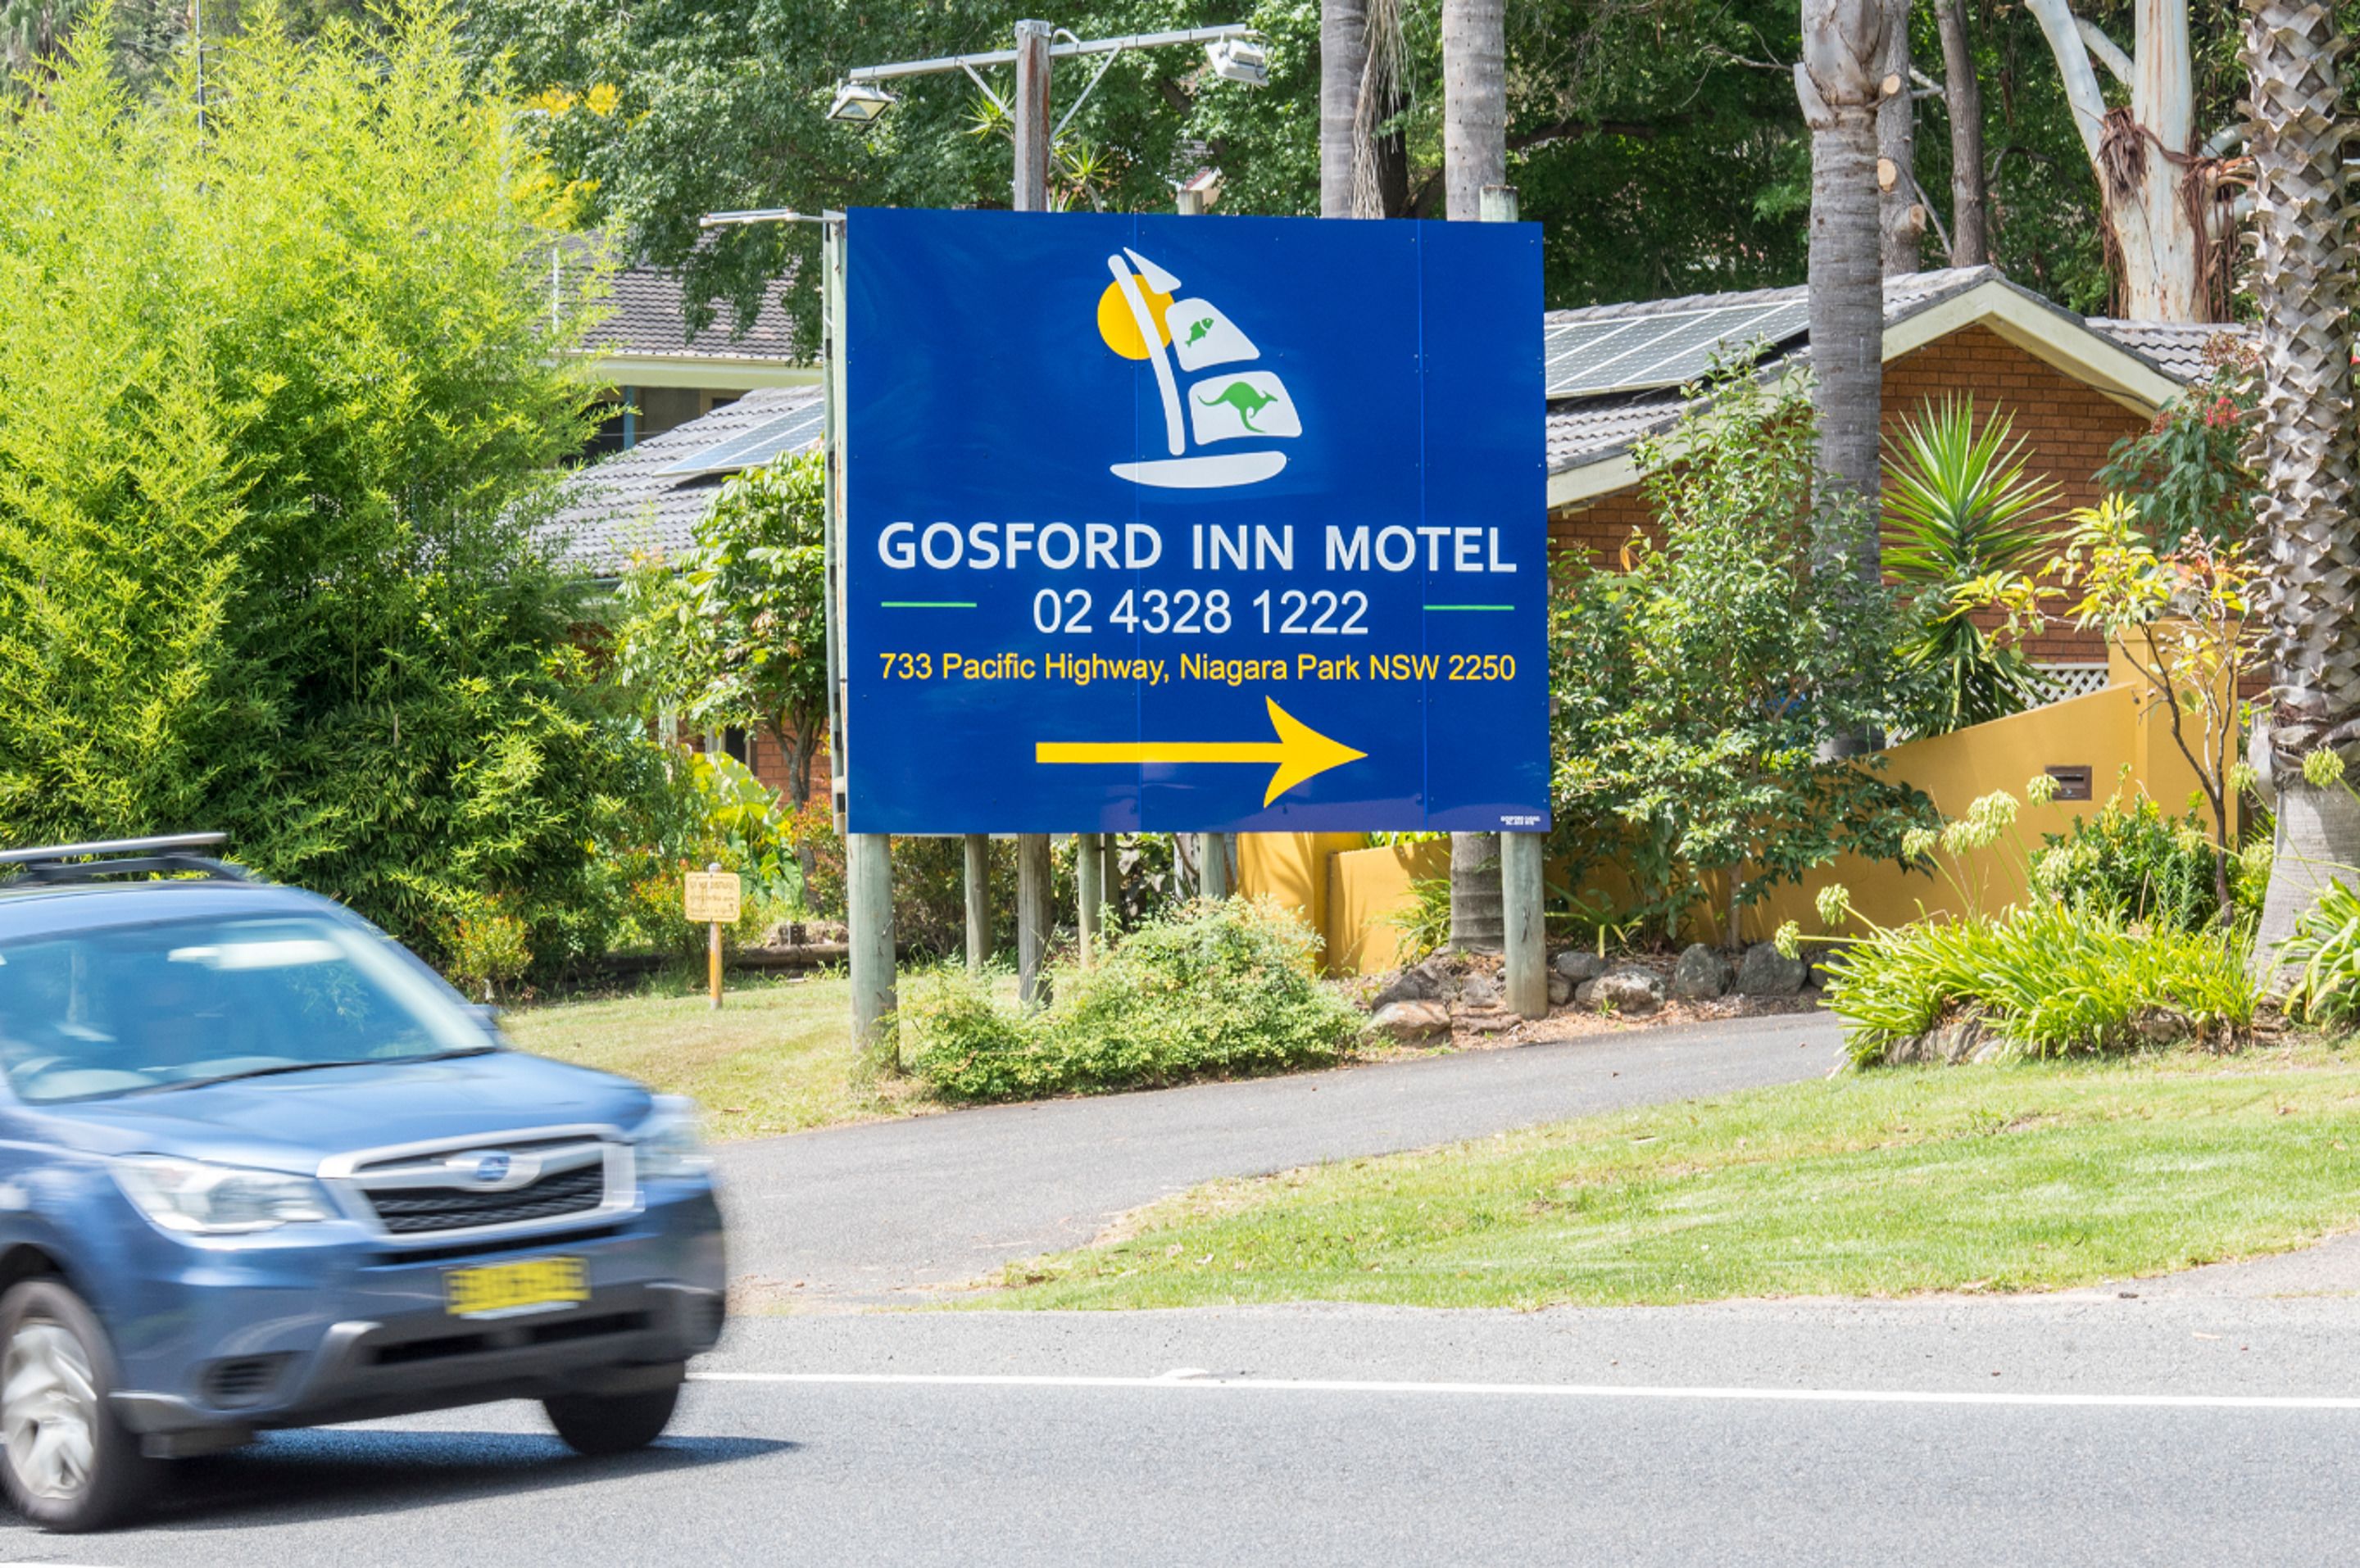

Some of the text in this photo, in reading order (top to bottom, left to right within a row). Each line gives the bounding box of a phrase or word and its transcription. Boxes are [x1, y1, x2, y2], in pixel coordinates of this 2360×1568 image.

[878, 523, 1517, 573] GOSFORD INN MOTEL
[1033, 588, 1368, 635] 02 4328 1222
[879, 652, 1516, 687] 733 Pacific Highway, Niagara Park NSW 2250
